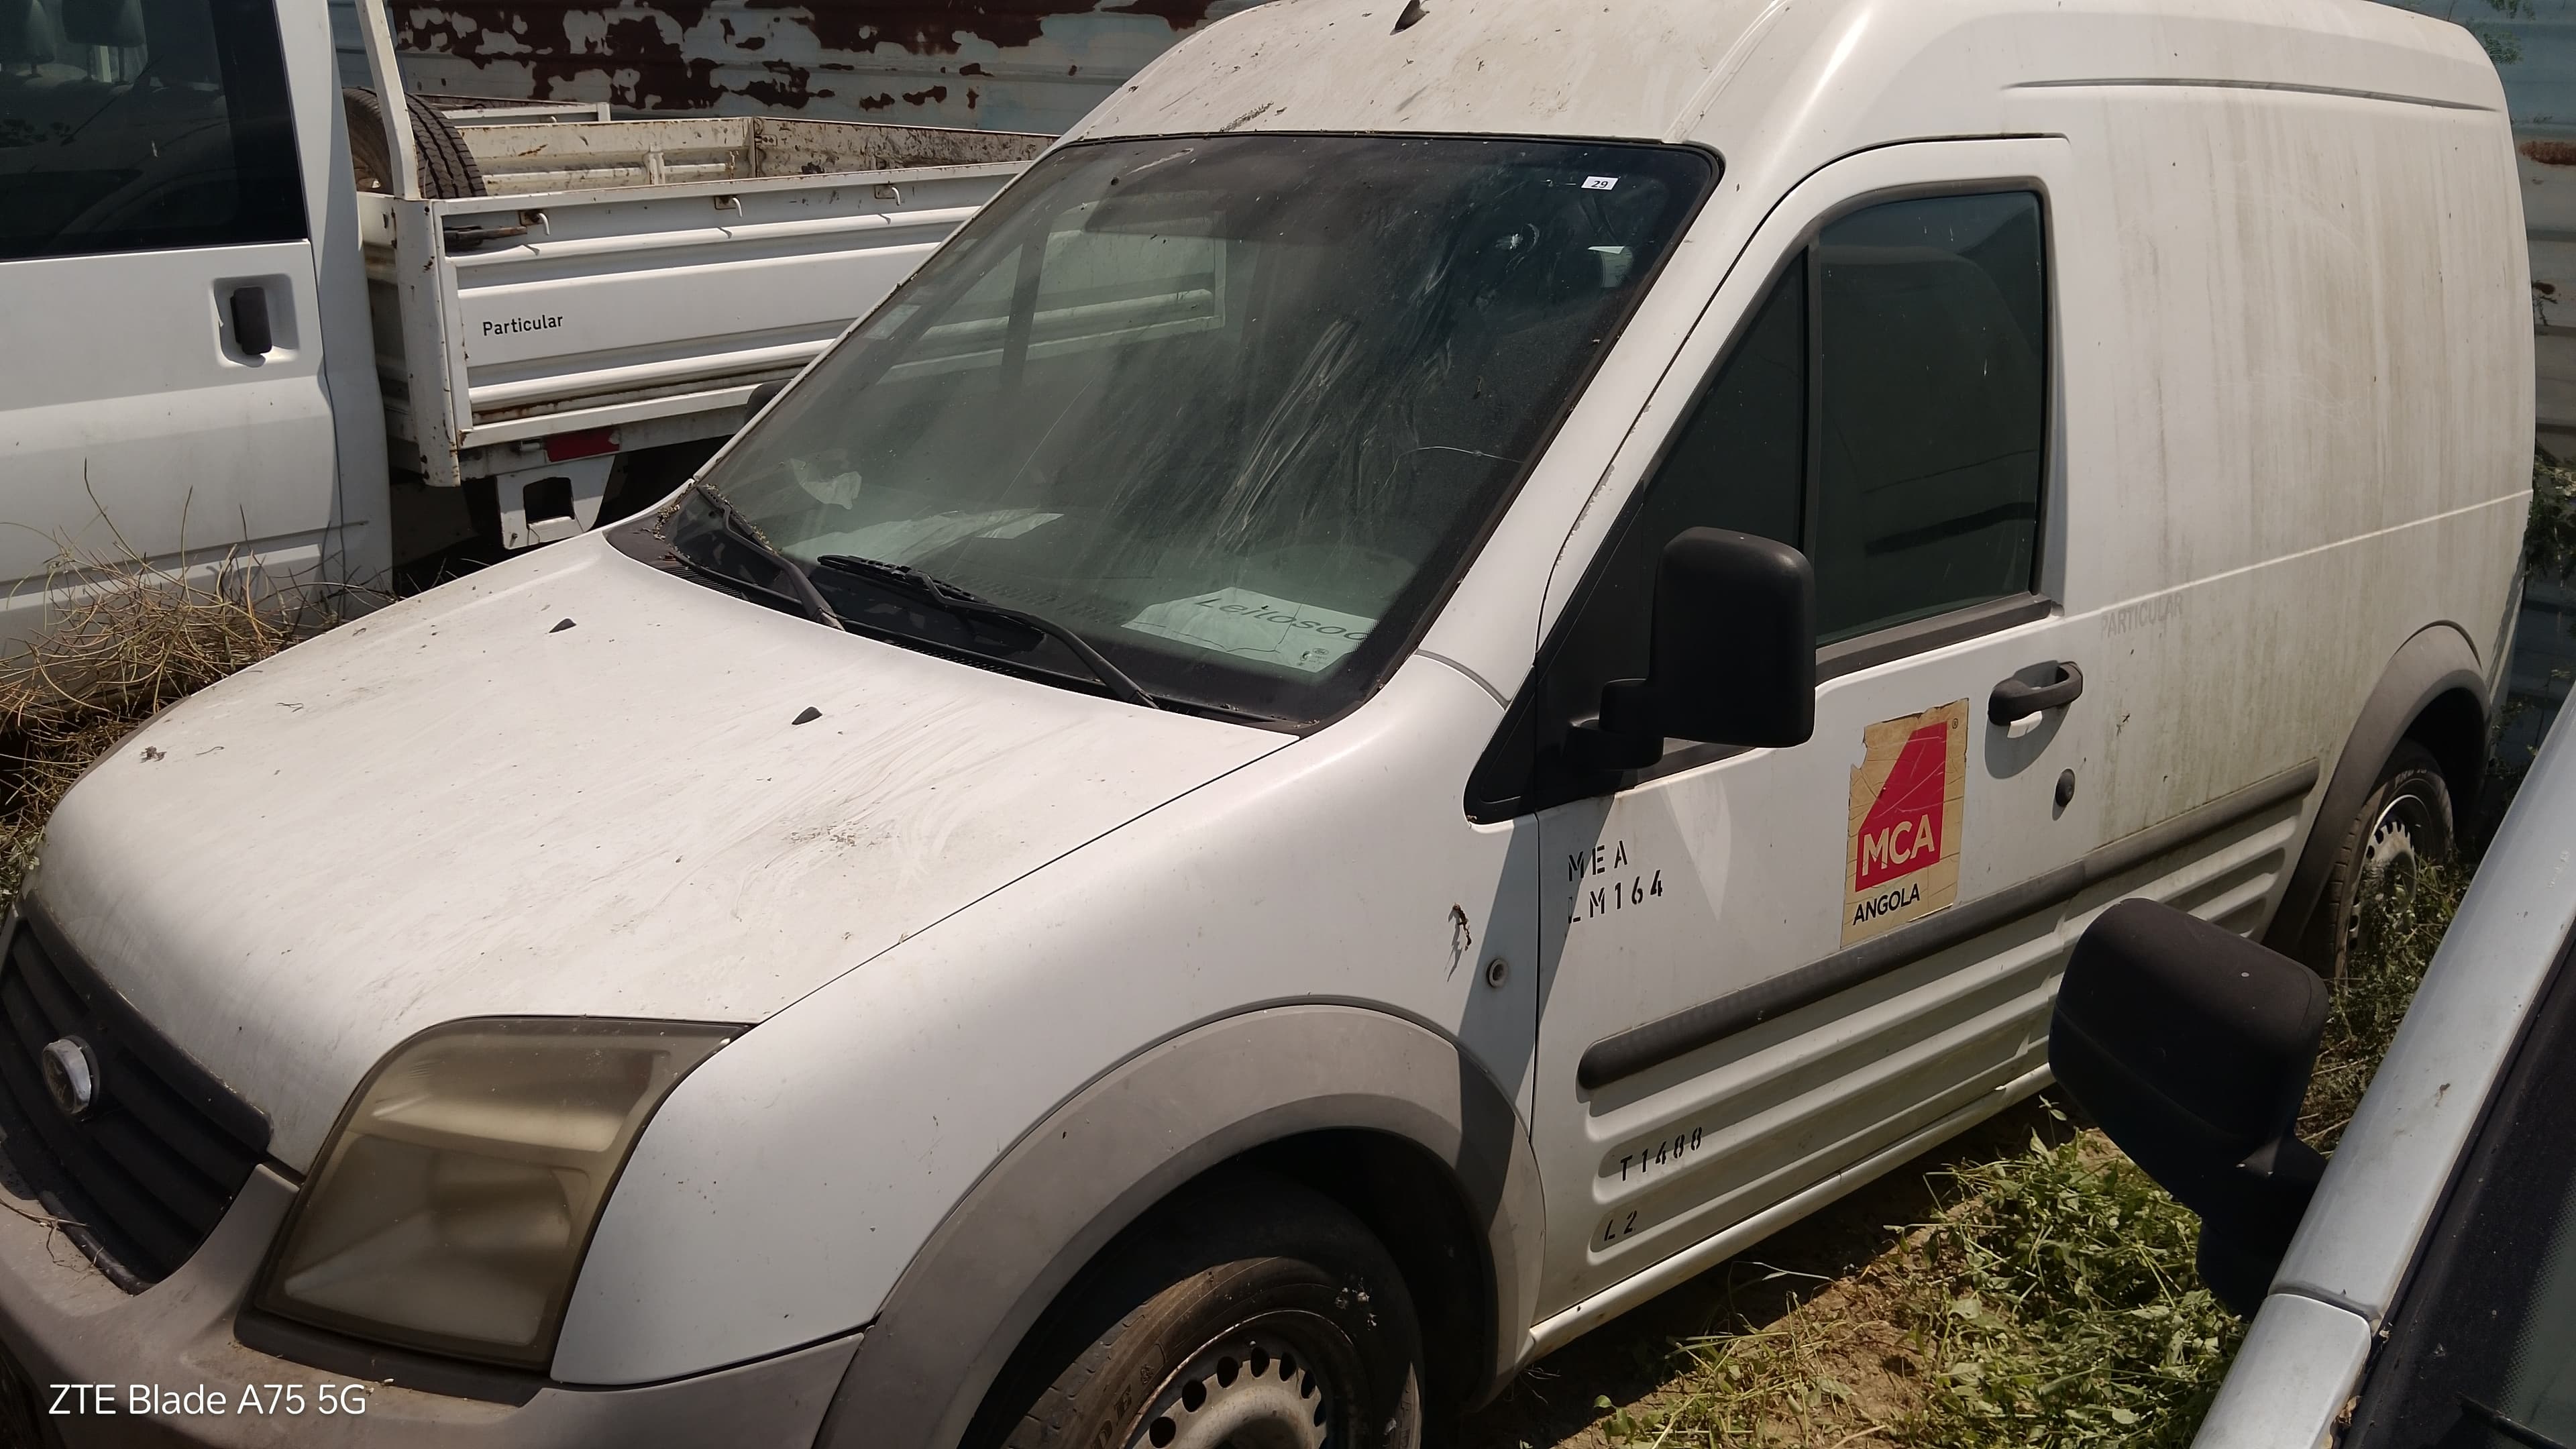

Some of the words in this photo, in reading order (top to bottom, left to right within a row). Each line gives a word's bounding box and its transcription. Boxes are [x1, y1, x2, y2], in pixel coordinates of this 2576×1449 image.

[1591, 180, 1609, 189] 29
[482, 314, 563, 336] Particular
[2100, 592, 2182, 638] PARTICULAR
[1568, 840, 1628, 882] MEA
[1862, 814, 1935, 877] MCA
[1852, 883, 1921, 926] ANGOLA
[1620, 1126, 1703, 1182] T1488
